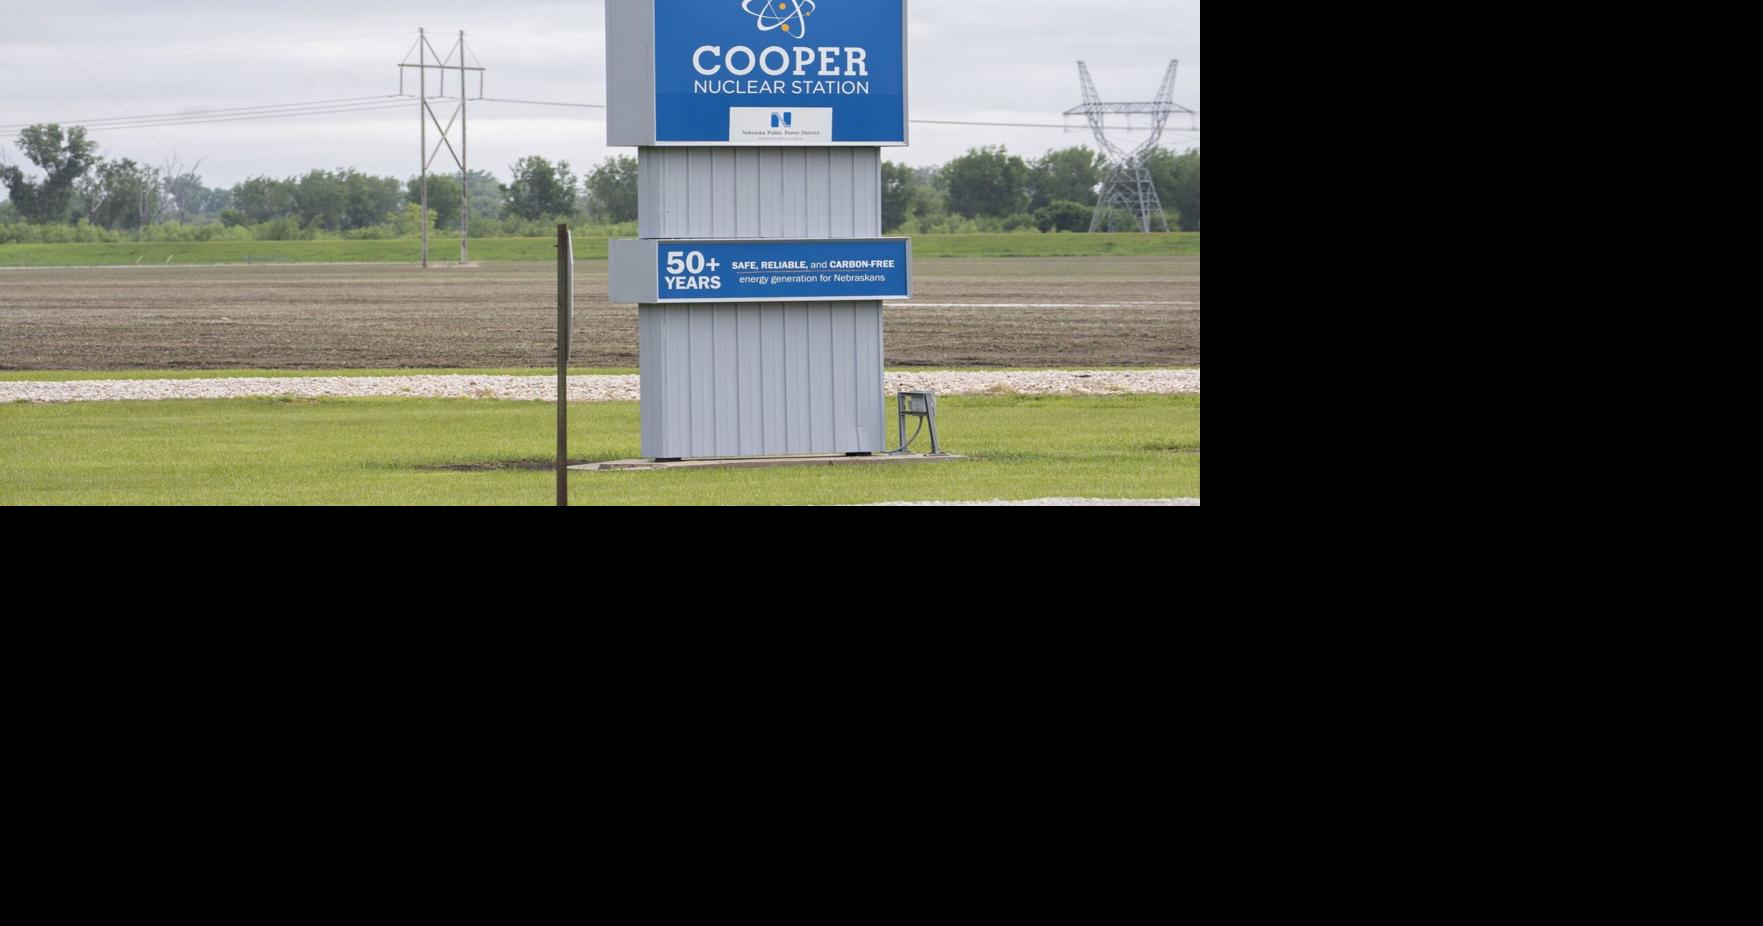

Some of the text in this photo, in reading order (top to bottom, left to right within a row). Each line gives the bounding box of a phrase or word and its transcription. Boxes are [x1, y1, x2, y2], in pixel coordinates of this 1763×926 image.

[692, 45, 869, 77] COOPER
[693, 80, 869, 95] NUCLEAR STATION
[665, 250, 721, 275] 50+
[731, 259, 895, 271] SAFE, RELIABLE, and CARBON-FREE
[664, 275, 722, 290] YEARS
[739, 273, 886, 285] energy generation for Nebraskans
